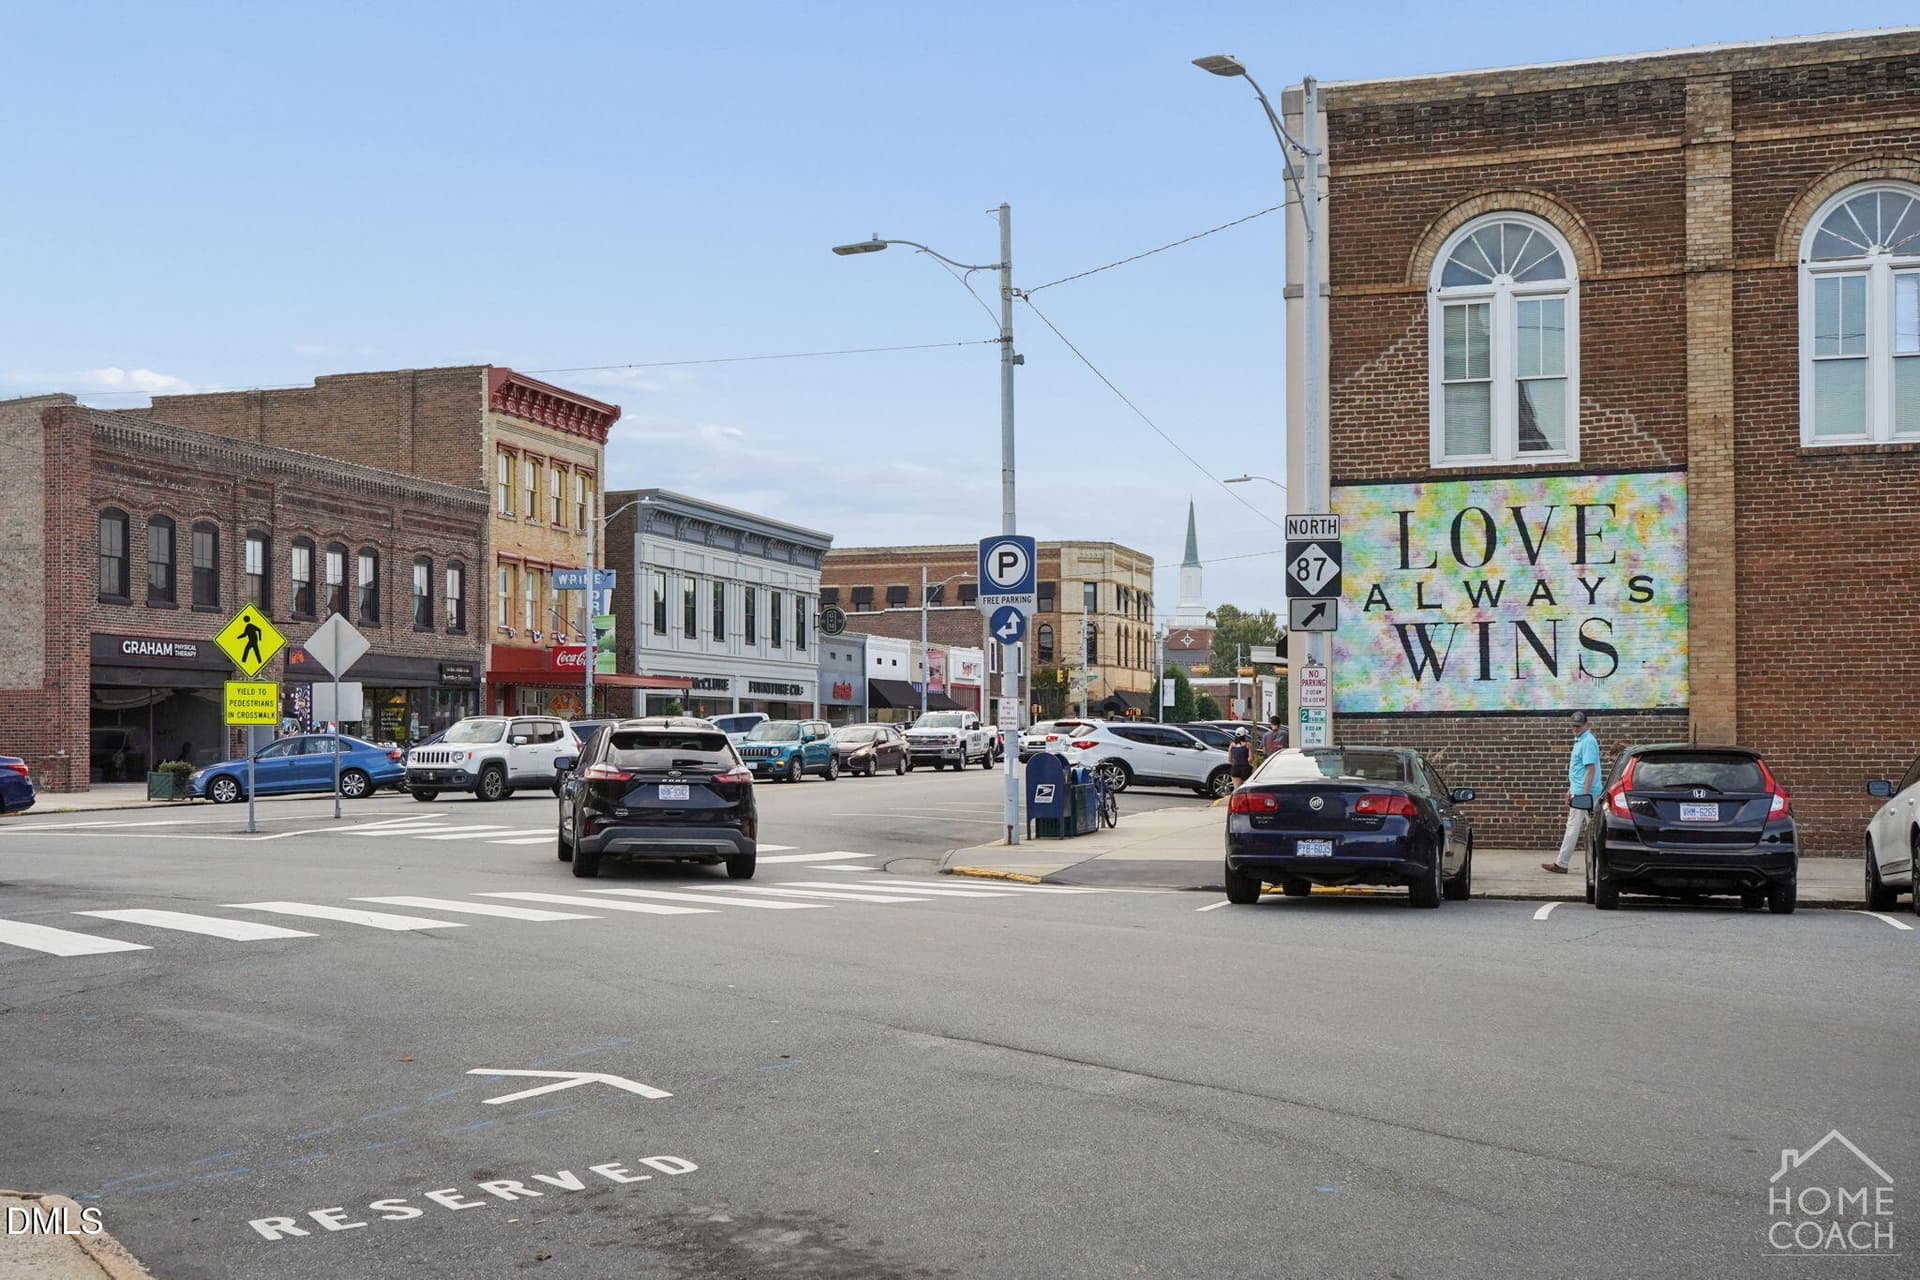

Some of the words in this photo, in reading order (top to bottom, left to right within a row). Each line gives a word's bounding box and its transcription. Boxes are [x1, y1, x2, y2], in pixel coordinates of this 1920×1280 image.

[1288, 519, 1338, 535] NORTH
[1392, 503, 1617, 570] LOVE
[998, 551, 1019, 579] P
[1296, 557, 1328, 582] 87
[1362, 574, 1655, 612] ALWAYS
[982, 596, 1000, 605] FREE
[1001, 595, 1032, 604] PARKING
[122, 640, 174, 656] GRAHAM
[174, 643, 197, 651] PHYSICAL
[1390, 616, 1620, 683] WINS
[174, 649, 197, 657] THERAPY
[1308, 670, 1320, 678] NO
[1301, 679, 1327, 687] PARKING
[236, 688, 256, 696] YIELD
[258, 688, 267, 696] TO
[229, 699, 274, 708] PEDESTRIANS
[227, 711, 235, 719] IN
[236, 711, 276, 719] CROSSWALK
[1301, 710, 1308, 721] 2
[247, 1154, 699, 1242] RESERVED
